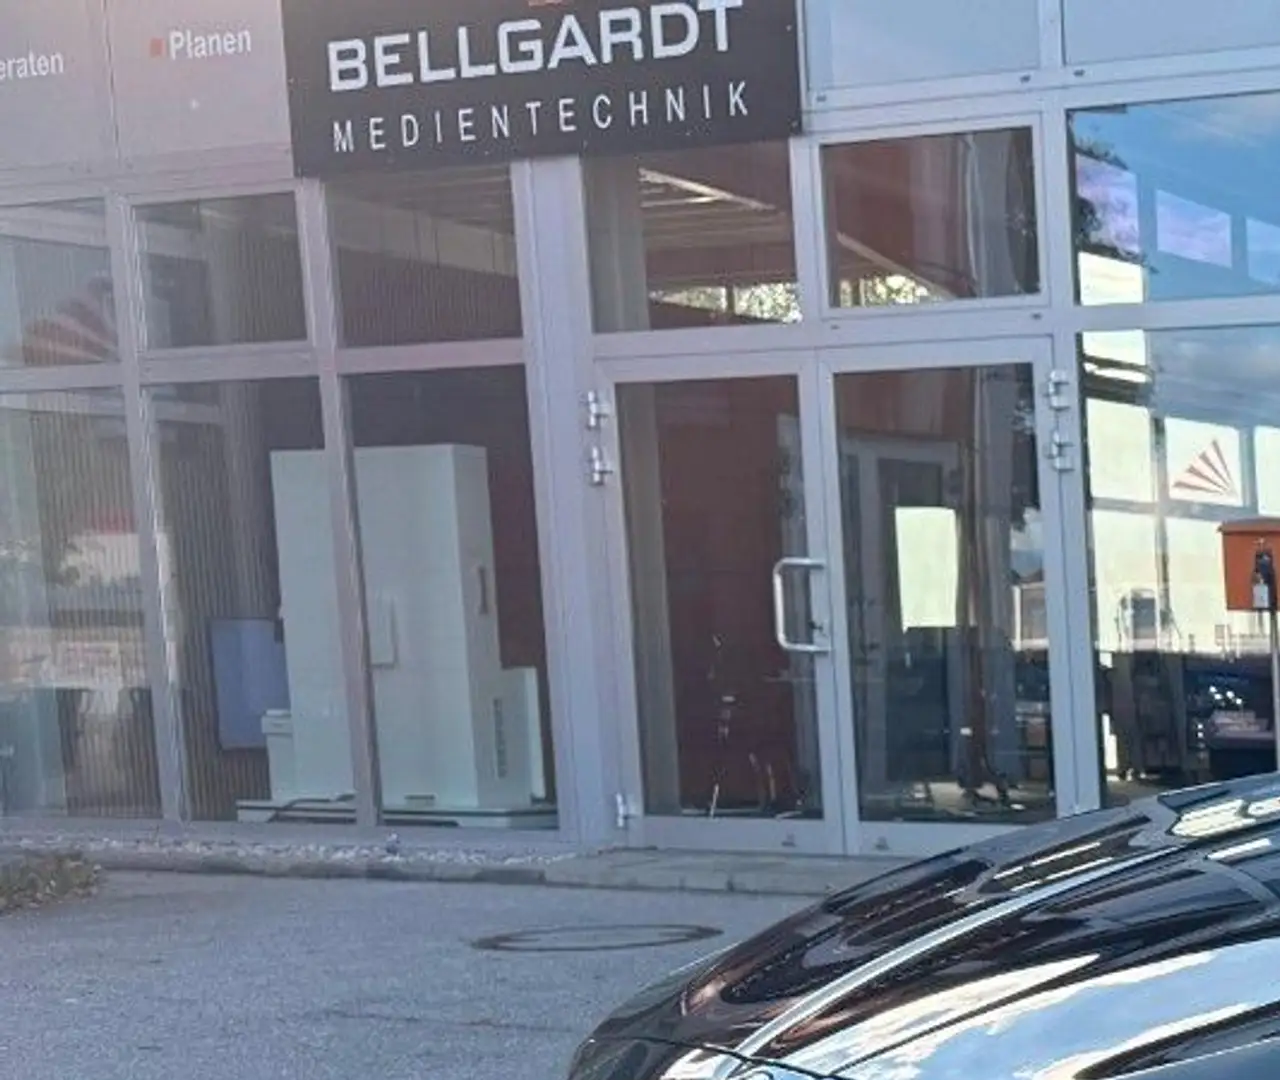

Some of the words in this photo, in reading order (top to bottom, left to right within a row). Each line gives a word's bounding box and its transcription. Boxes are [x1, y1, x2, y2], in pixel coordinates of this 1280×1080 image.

[168, 28, 253, 60] Planen
[328, 0, 743, 92] BELLGARDT
[332, 80, 749, 154] MEDIENTECHNIK
